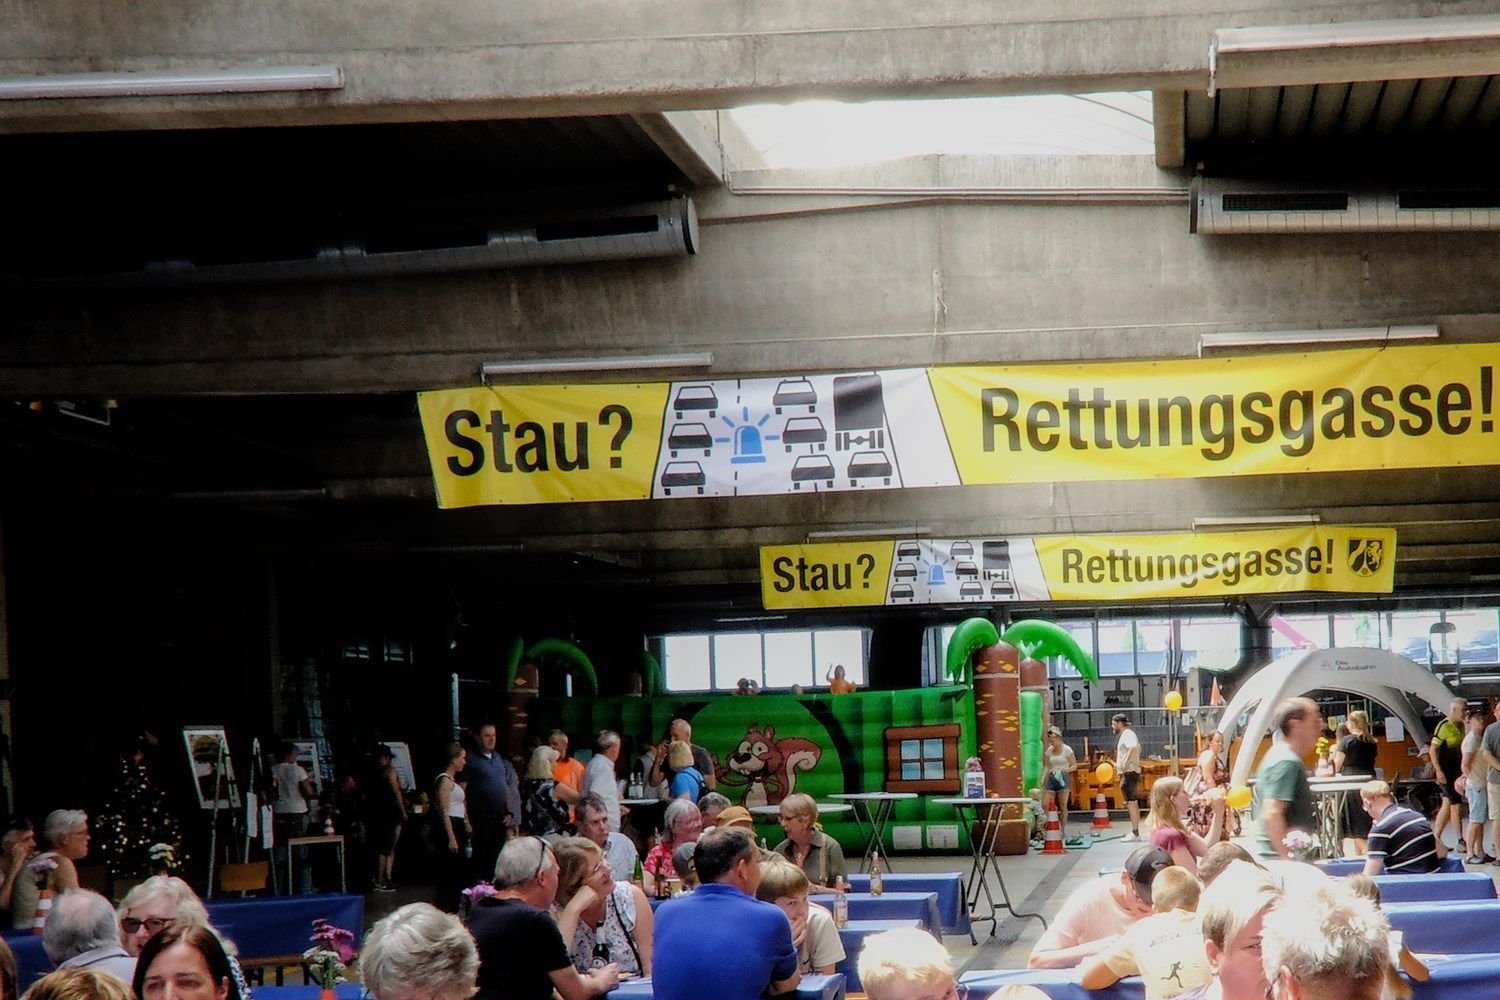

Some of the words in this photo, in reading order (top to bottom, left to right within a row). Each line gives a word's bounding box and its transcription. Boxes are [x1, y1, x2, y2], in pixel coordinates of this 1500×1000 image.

[444, 403, 633, 477] Stau?
[979, 365, 1495, 461] Rettungsgasse!
[772, 552, 876, 593] Stau?
[1060, 538, 1333, 587] Rettungsgasse!
